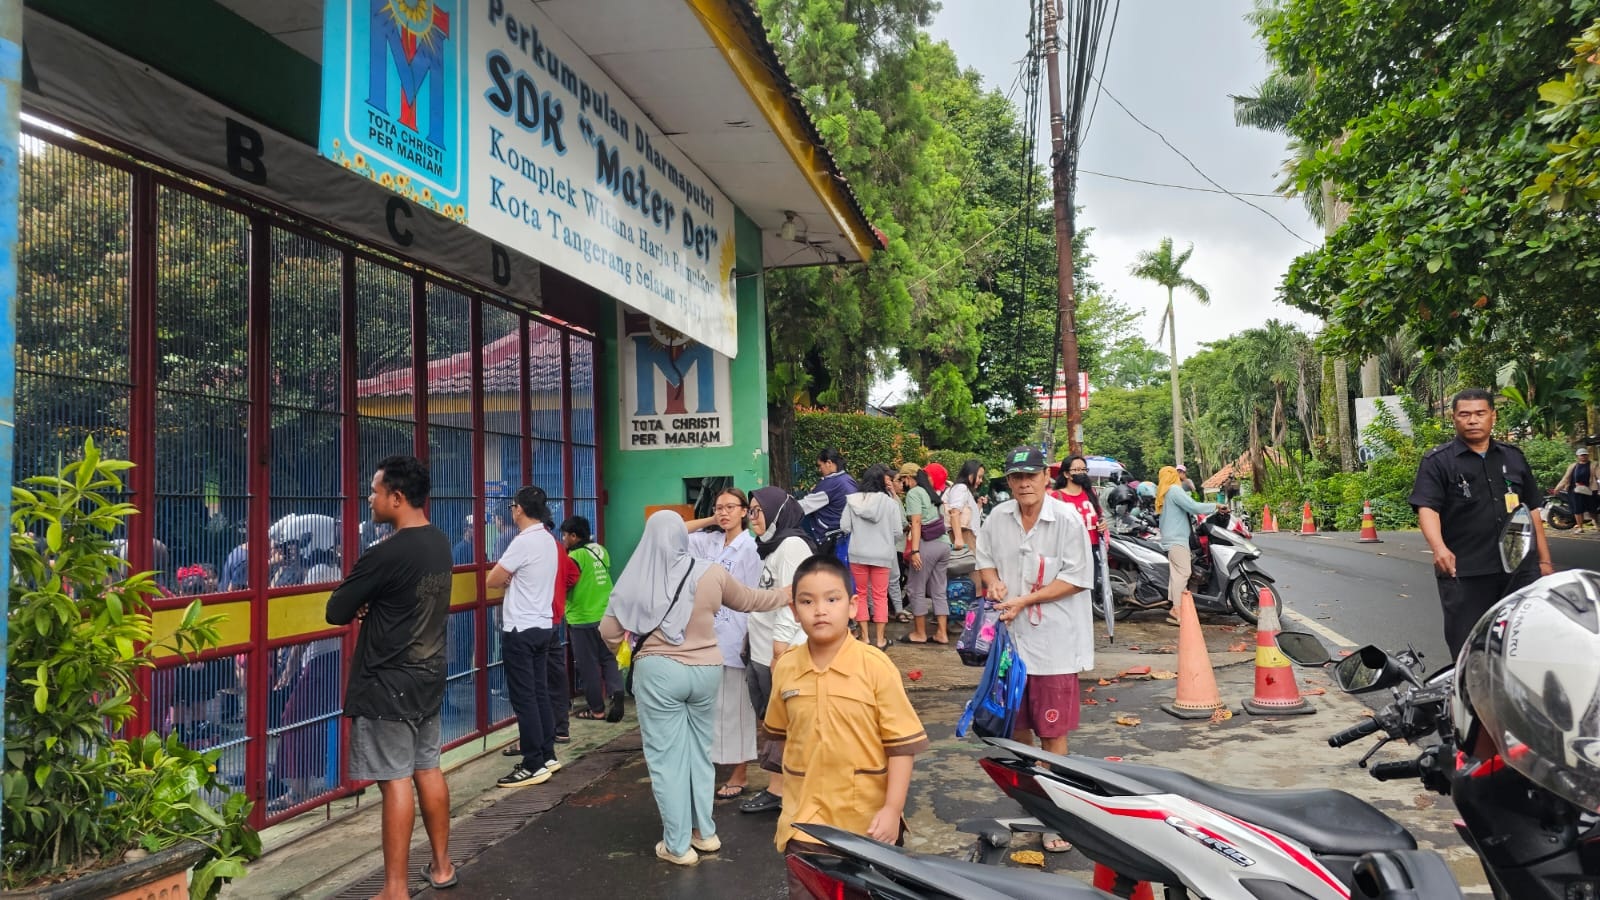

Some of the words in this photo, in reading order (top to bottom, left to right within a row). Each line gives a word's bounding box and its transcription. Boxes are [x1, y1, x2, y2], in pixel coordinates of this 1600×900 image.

[485, 50, 567, 156] SDK
[488, 0, 629, 142] Perkumpulan
[635, 123, 715, 218] Dharmaputri
[226, 117, 267, 186] B
[367, 110, 397, 135] TOTA
[400, 130, 443, 162] CHRISTI
[368, 127, 393, 150] PER
[397, 143, 443, 177] MARIAM
[385, 196, 414, 246] C
[489, 125, 577, 208] Komplek
[582, 189, 634, 244] Witana
[639, 228, 669, 266] Harja
[489, 176, 541, 231] Kota
[547, 208, 632, 285] Tangerang
[636, 262, 676, 304] Selatan
[491, 243, 511, 287] D
[631, 419, 663, 431] TOTA
[672, 417, 720, 429] CHRISTI
[631, 433, 657, 445] PER
[664, 431, 721, 444] MARIAM
